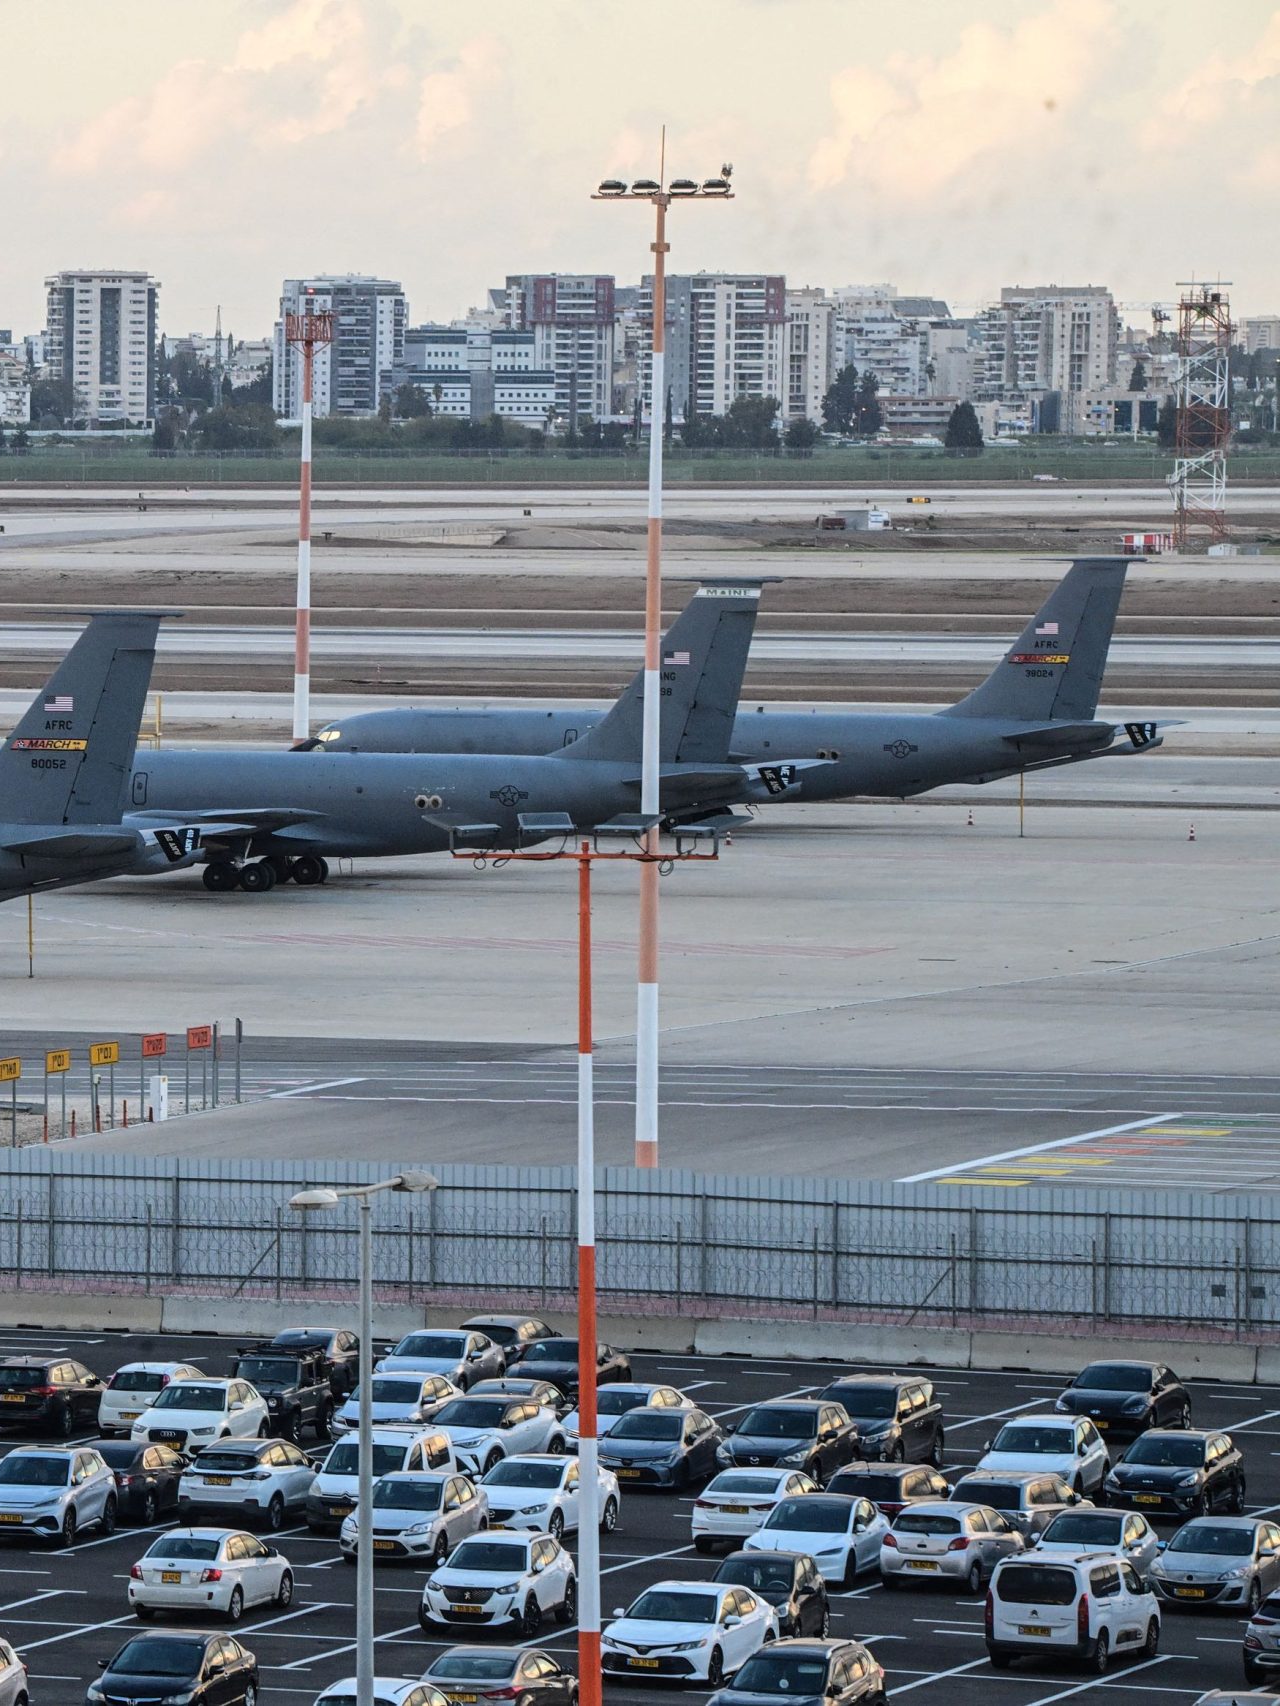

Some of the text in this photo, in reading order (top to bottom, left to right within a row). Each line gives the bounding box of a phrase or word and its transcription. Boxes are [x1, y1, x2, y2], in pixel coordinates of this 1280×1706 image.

[1034, 640, 1059, 649] AFRC
[45, 720, 73, 730] AFRC
[27, 740, 71, 749] MARCH
[31, 758, 66, 769] 80052
